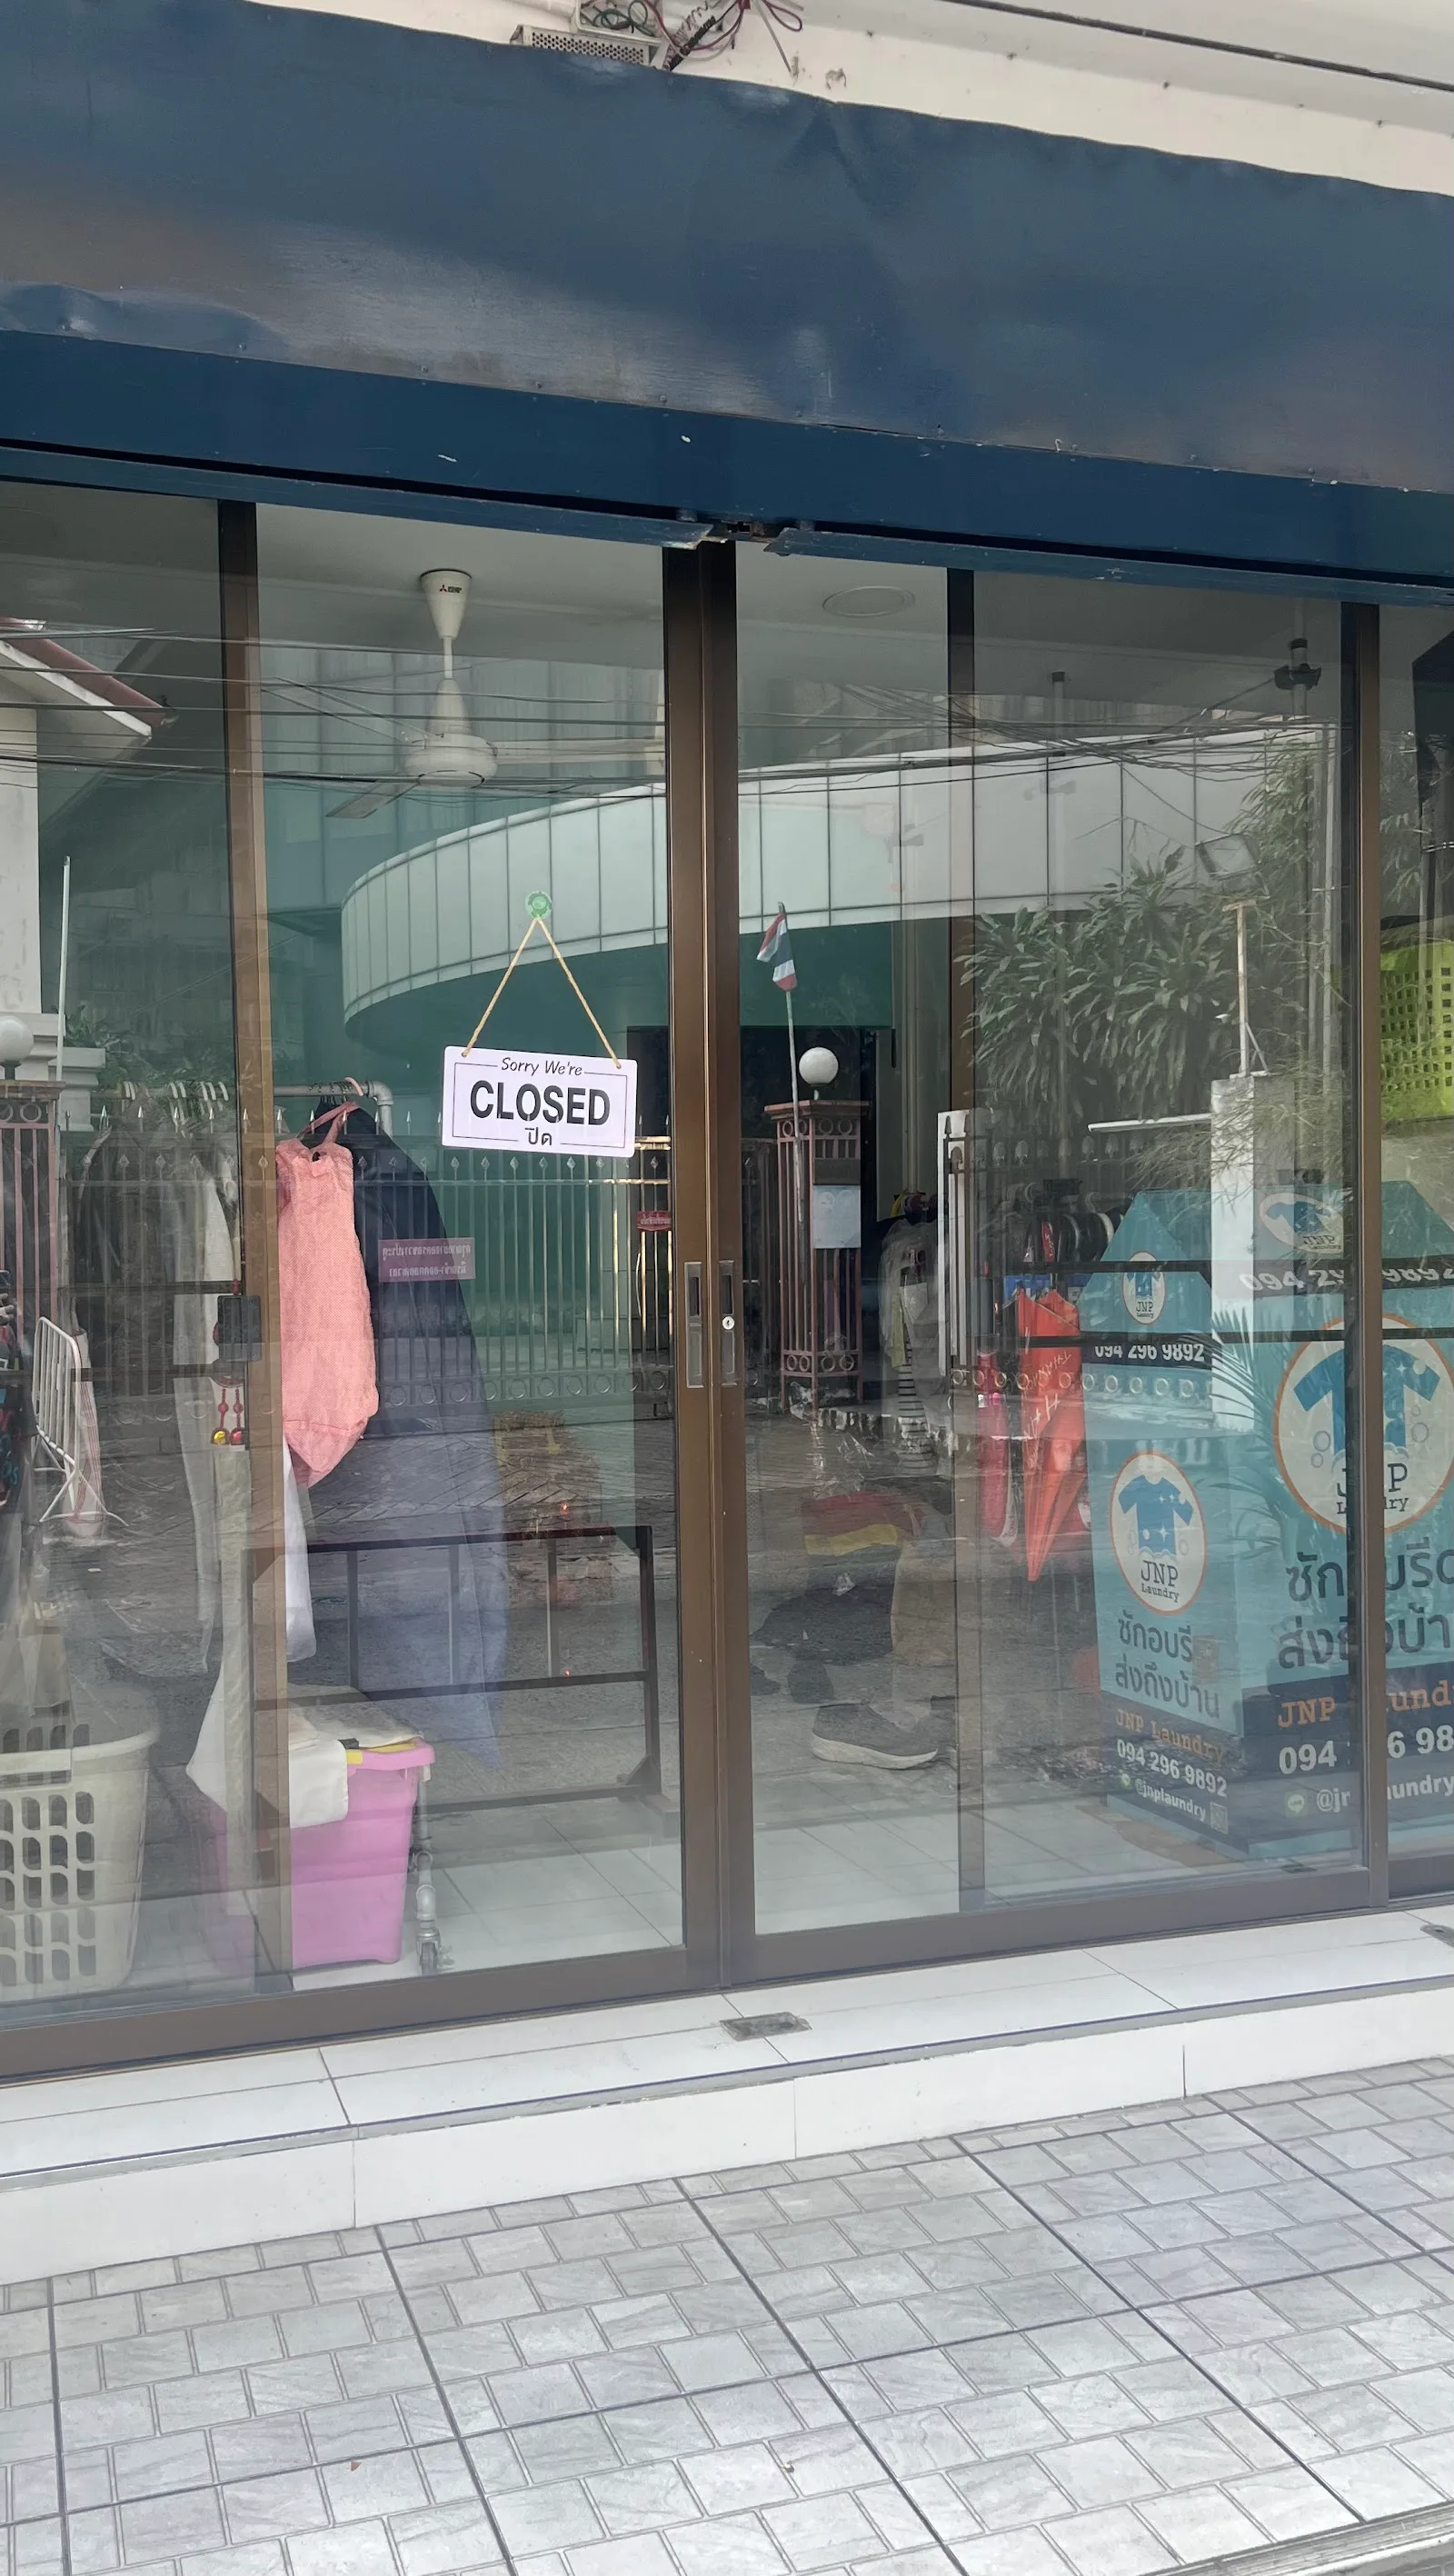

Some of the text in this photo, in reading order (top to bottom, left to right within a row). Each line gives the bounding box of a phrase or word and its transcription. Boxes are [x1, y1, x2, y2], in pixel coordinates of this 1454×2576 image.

[502, 1057, 583, 1076] Sorry We're
[470, 1080, 611, 1126] CLOSED
[524, 1127, 553, 1146] ปิด
[1240, 1271, 1305, 1291] 094
[1135, 1301, 1154, 1313] JNP
[1094, 1343, 1205, 1362] 094 296 9892
[1140, 1560, 1179, 1587] JNP
[1140, 1583, 1180, 1603] Laundry
[1115, 1652, 1220, 1718] ส่งถึงบ้าน
[1279, 1696, 1336, 1727] JNP
[1116, 1709, 1224, 1763] JNP Laundry
[1117, 1739, 1227, 1798] 094 296 9892
[1280, 1740, 1337, 1774] 094
[1134, 1778, 1206, 1822] @jnplaundry
